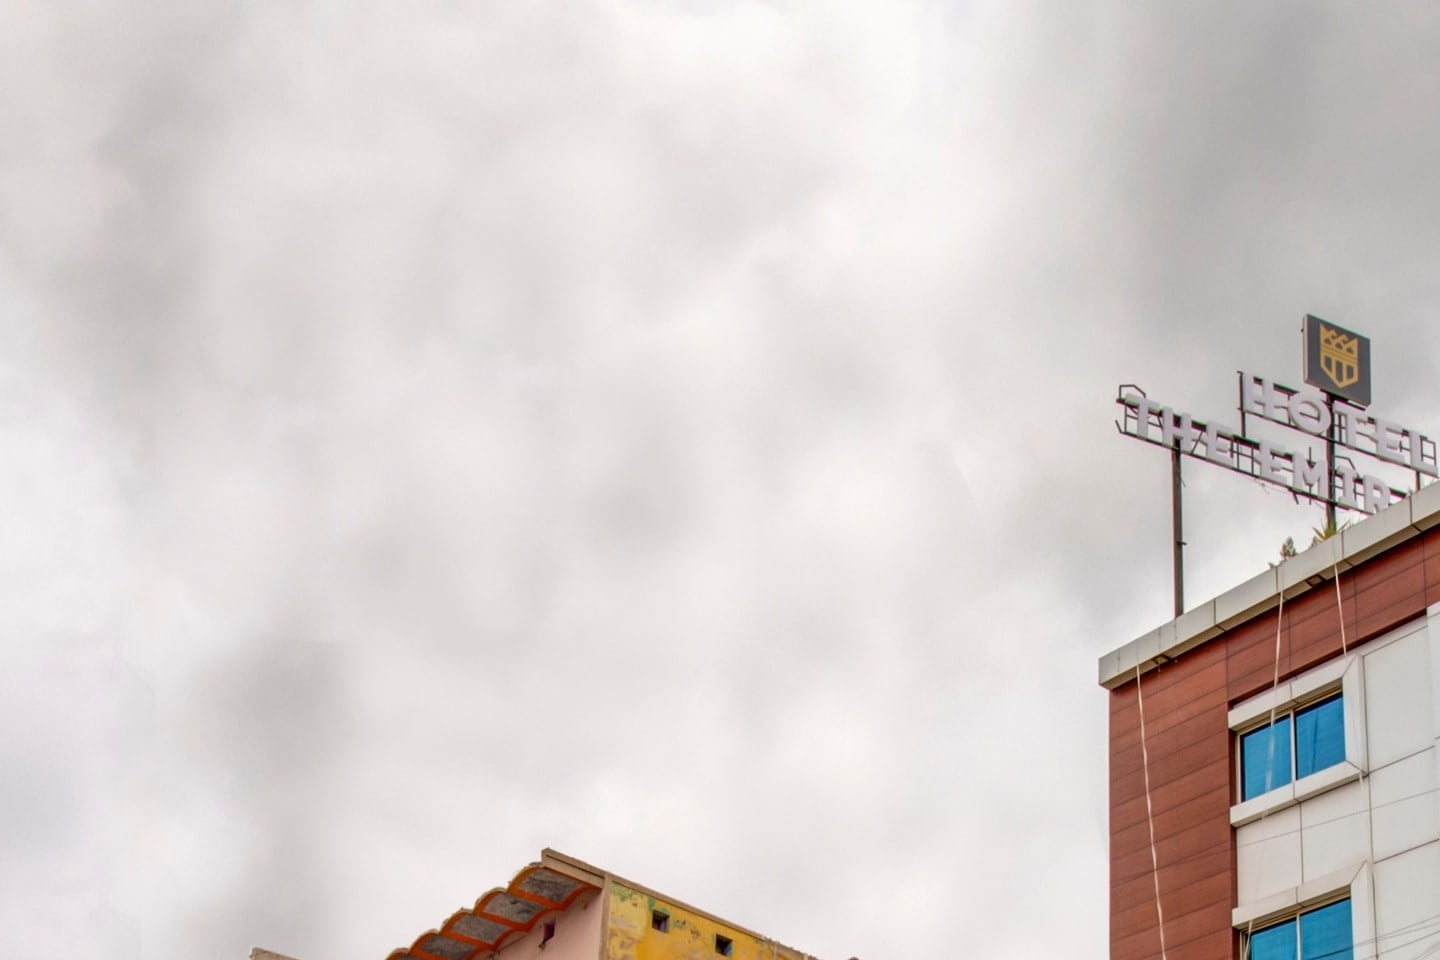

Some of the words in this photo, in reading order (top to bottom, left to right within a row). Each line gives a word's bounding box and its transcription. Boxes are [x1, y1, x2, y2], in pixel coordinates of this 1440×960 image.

[1124, 393, 1236, 460] THE
[1260, 440, 1394, 514] EMIR
[1241, 372, 1439, 478] HOTEL
